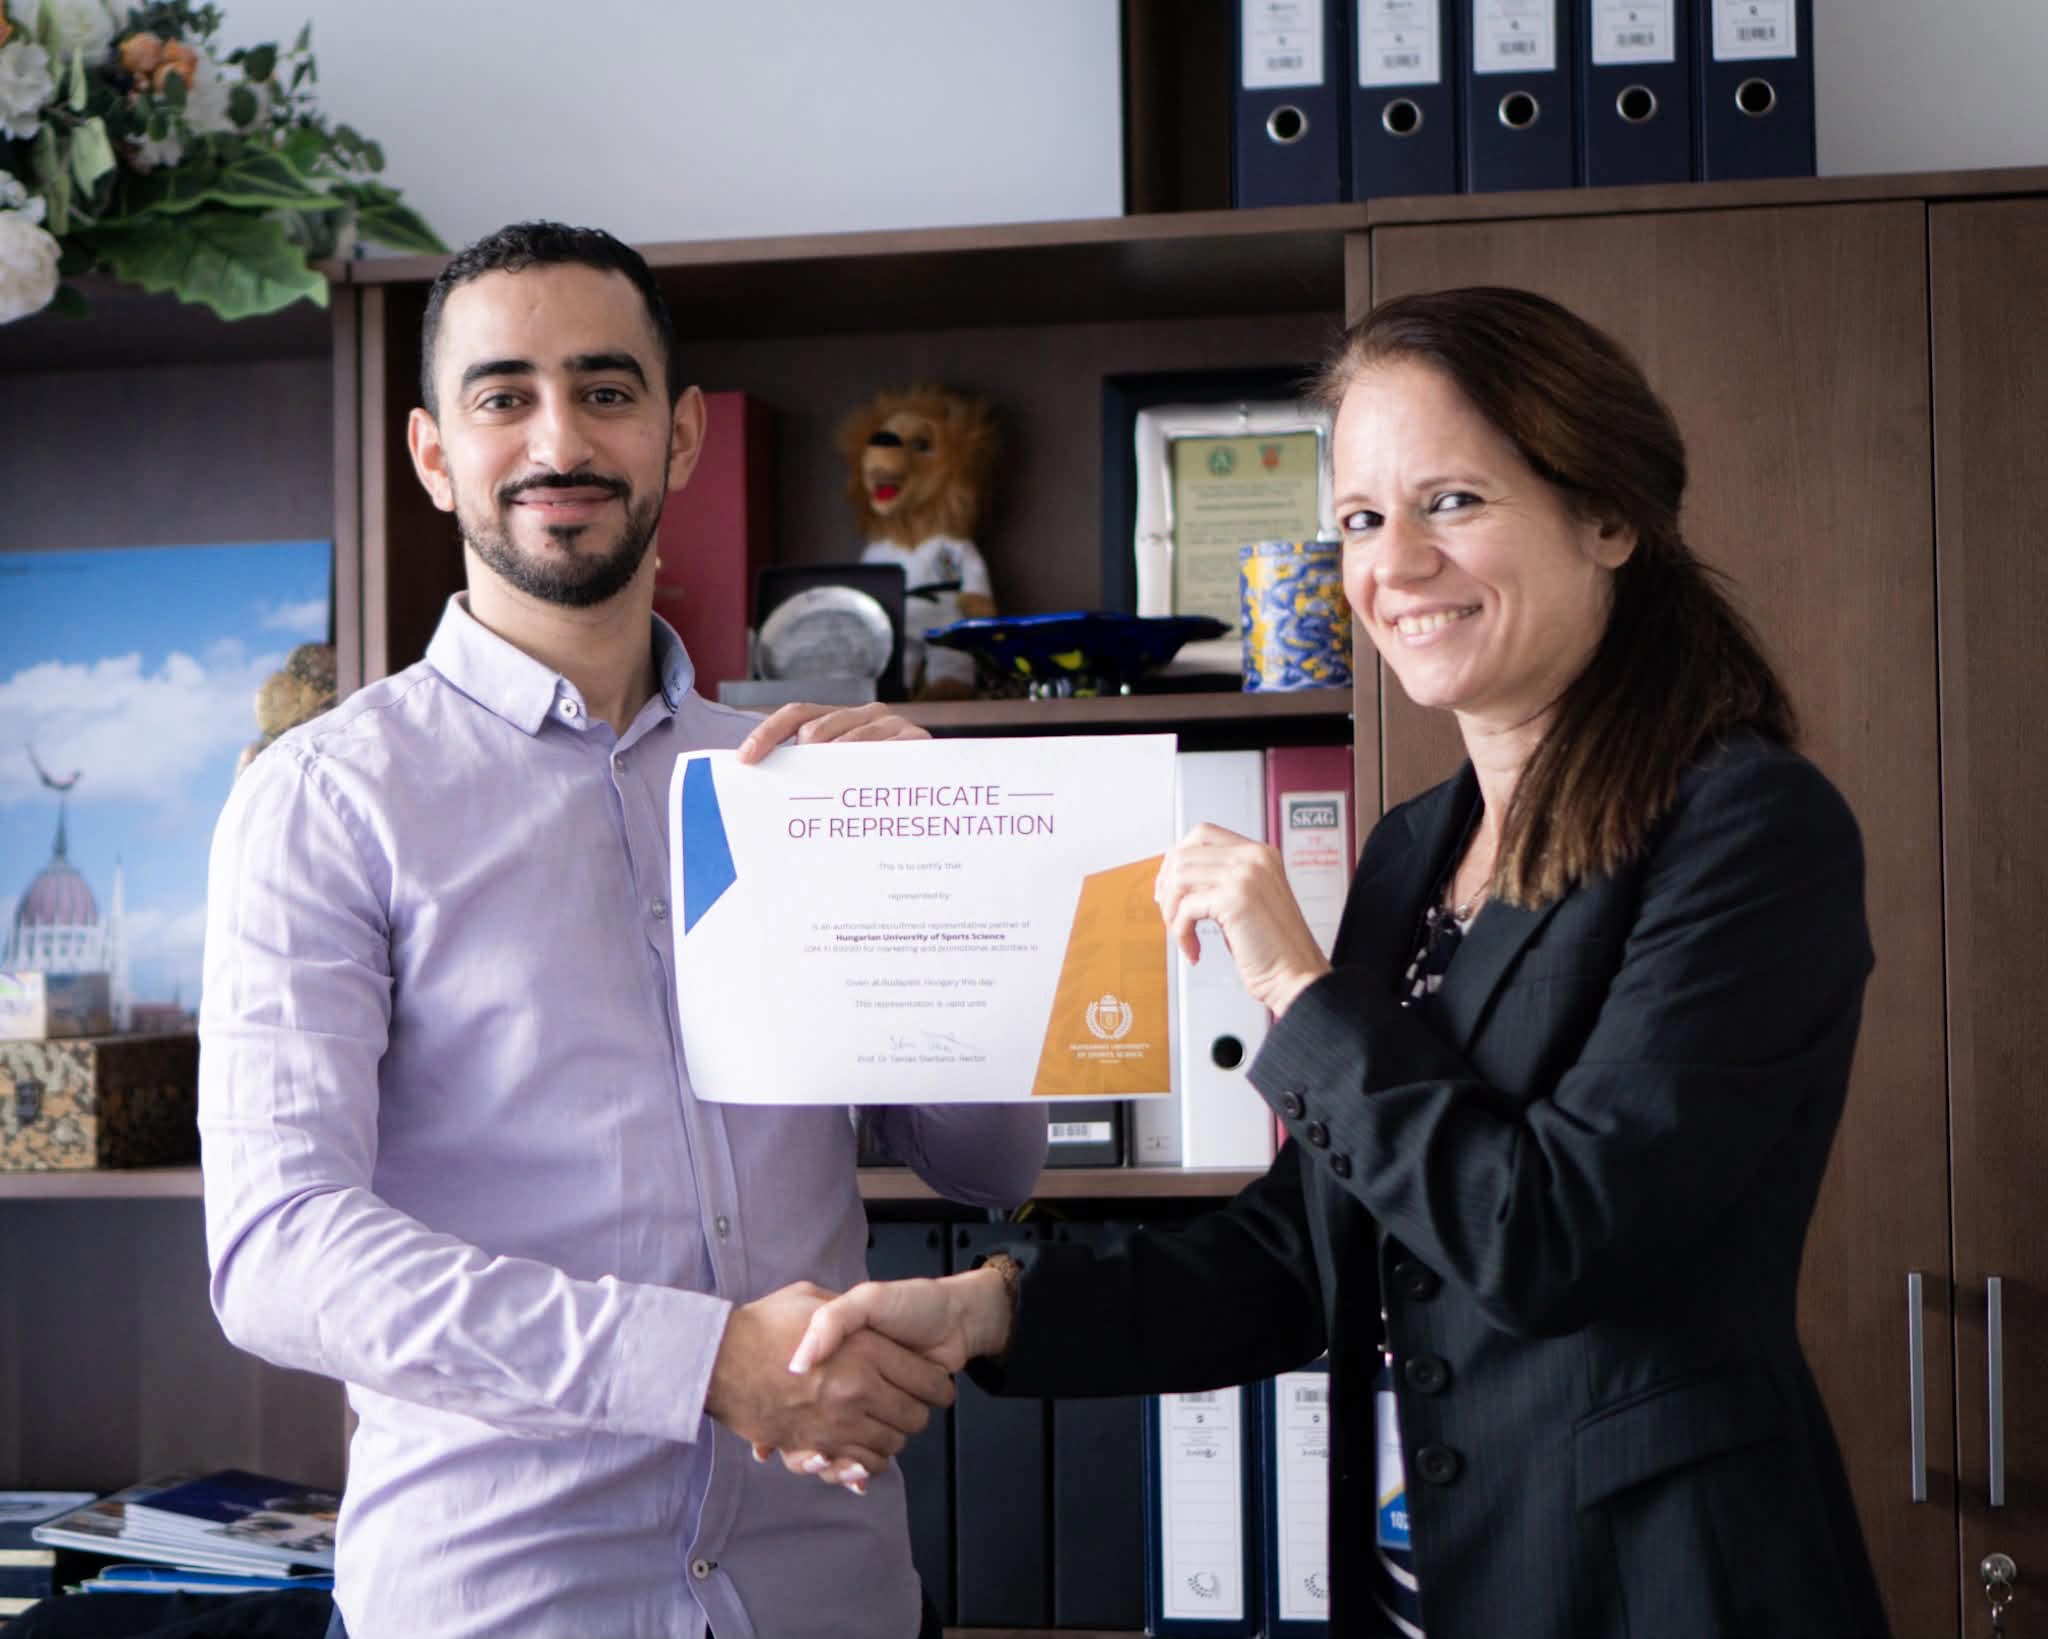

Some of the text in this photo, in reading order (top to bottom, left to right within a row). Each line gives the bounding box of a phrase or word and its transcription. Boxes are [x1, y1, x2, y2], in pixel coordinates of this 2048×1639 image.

[841, 785, 1001, 808] CERTIFICATE
[787, 814, 1055, 839] OF REPRESENTATION
[879, 861, 896, 871] This
[916, 860, 943, 873] certify
[887, 890, 938, 903] represented
[836, 932, 1006, 943] Hungarian University of Sports Science
